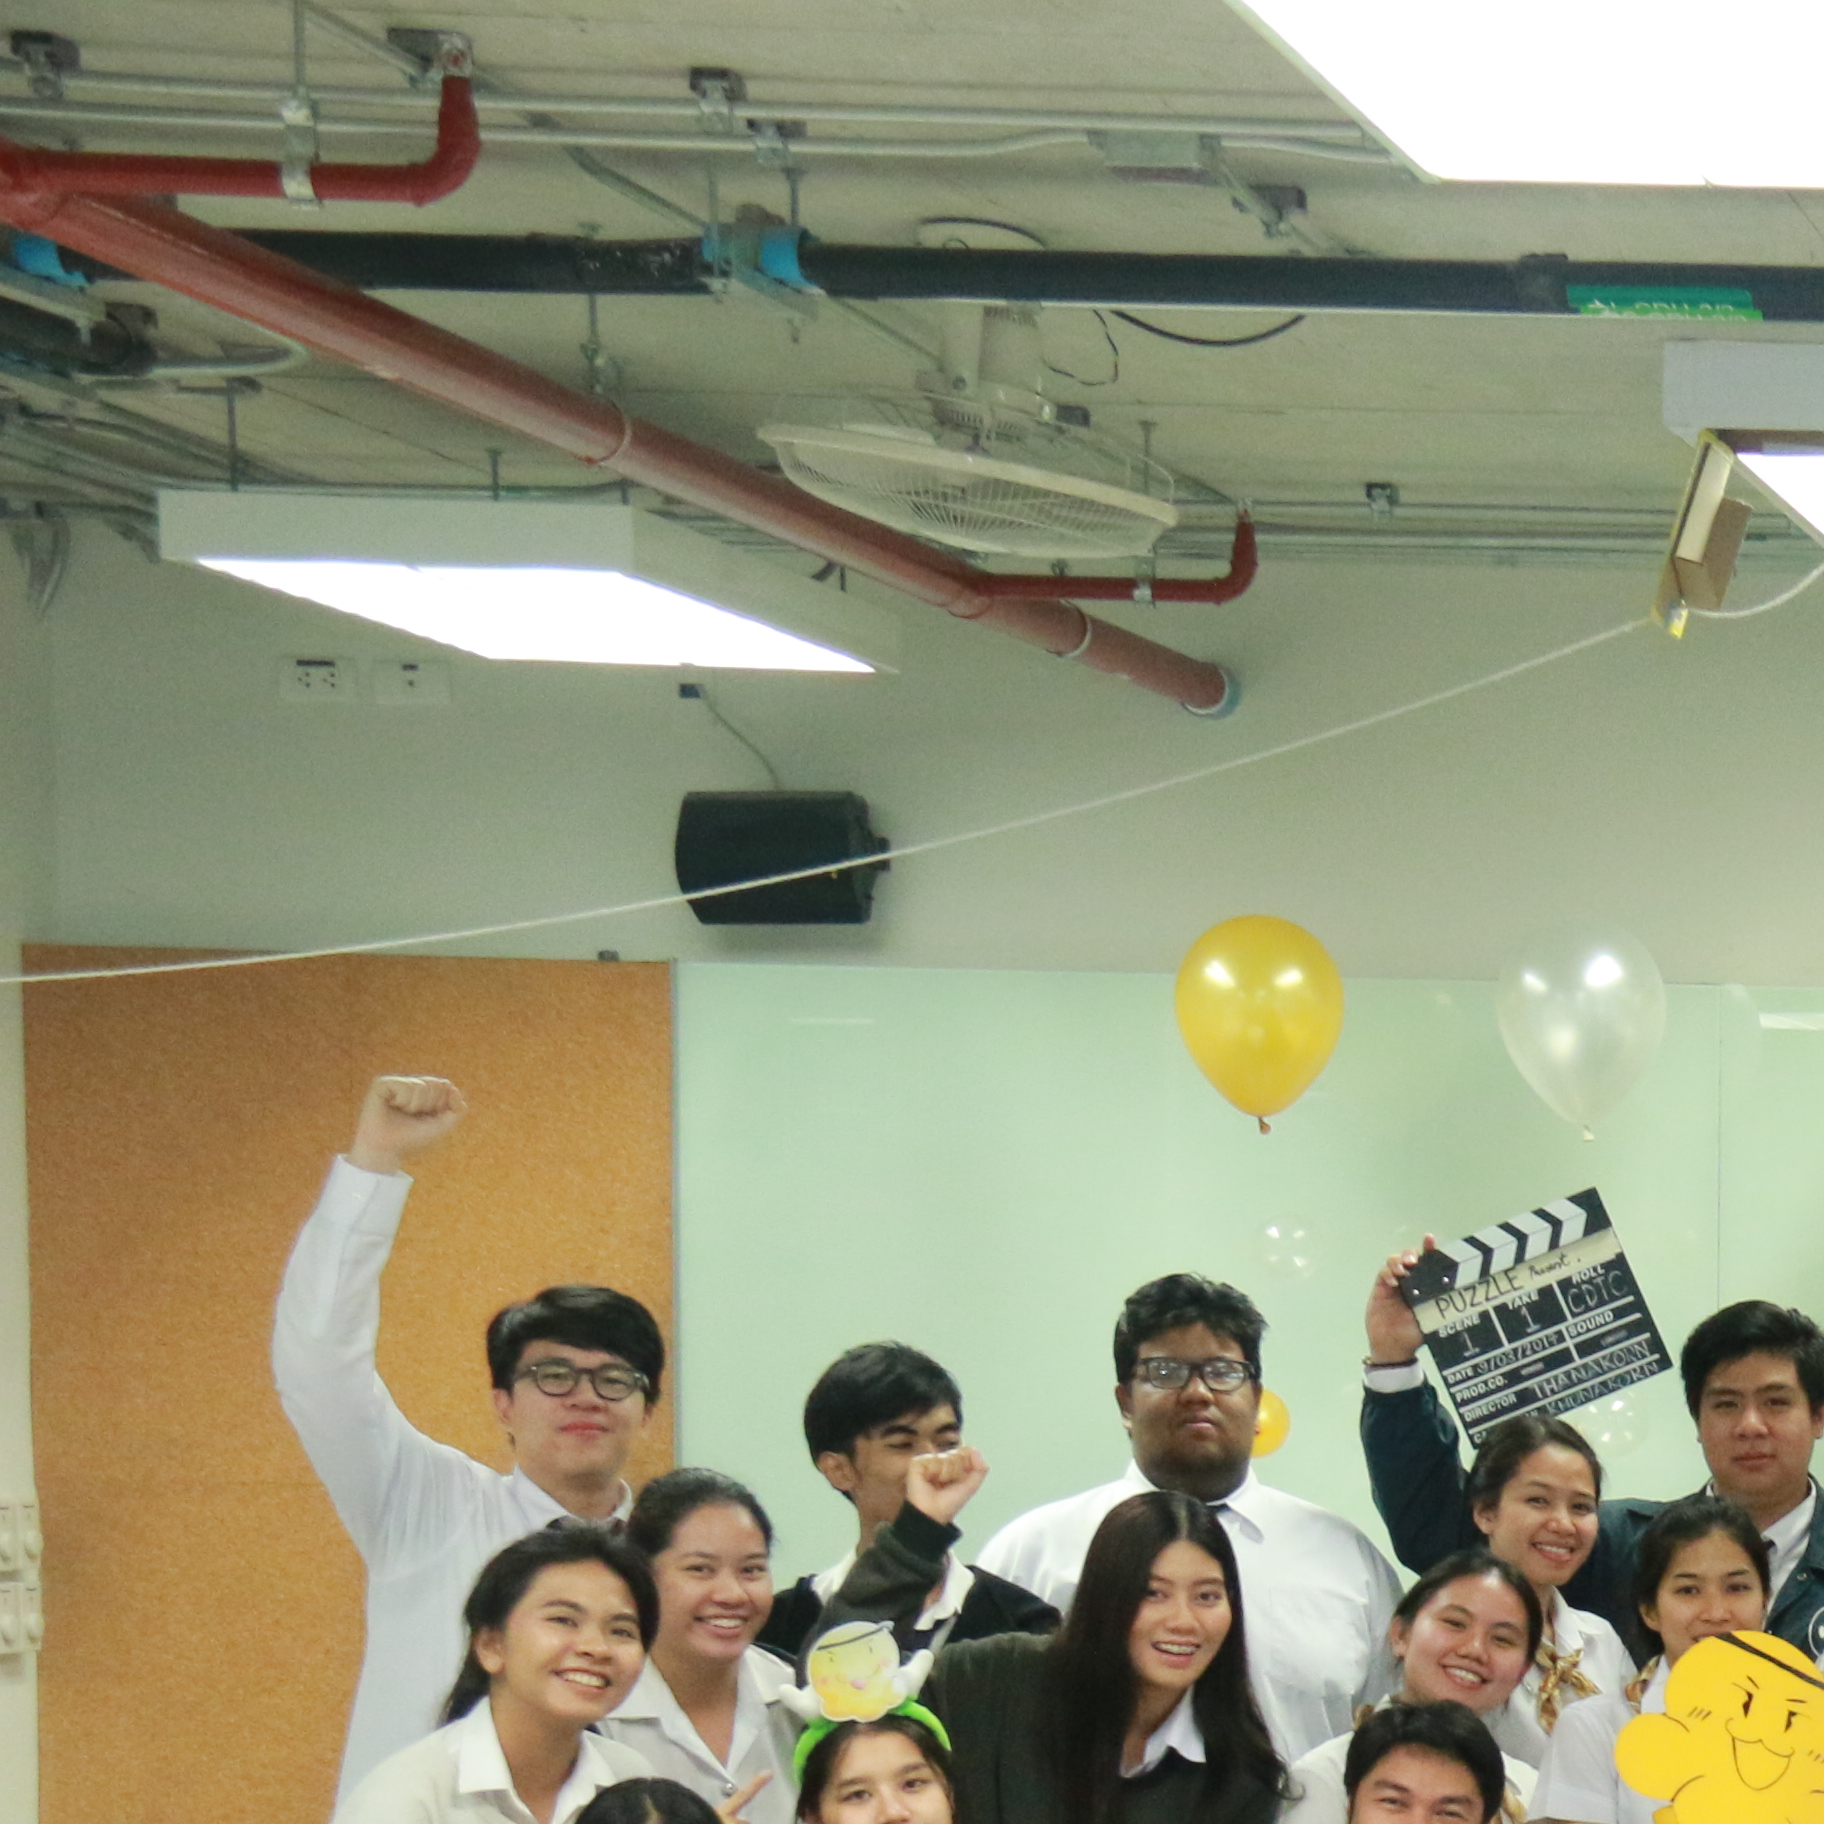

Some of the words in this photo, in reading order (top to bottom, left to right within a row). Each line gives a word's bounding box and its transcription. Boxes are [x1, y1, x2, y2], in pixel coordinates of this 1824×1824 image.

[1571, 1263, 1606, 1285] ROLL
[1434, 1268, 1524, 1319] PUZZLE
[1506, 1289, 1540, 1311] TAKE
[1567, 1269, 1628, 1313] CDTC
[1438, 1312, 1481, 1338] SCENE
[1567, 1310, 1615, 1337] SOUND
[1447, 1367, 1475, 1385] DATE
[1463, 1392, 1518, 1423] DIRECTOR
